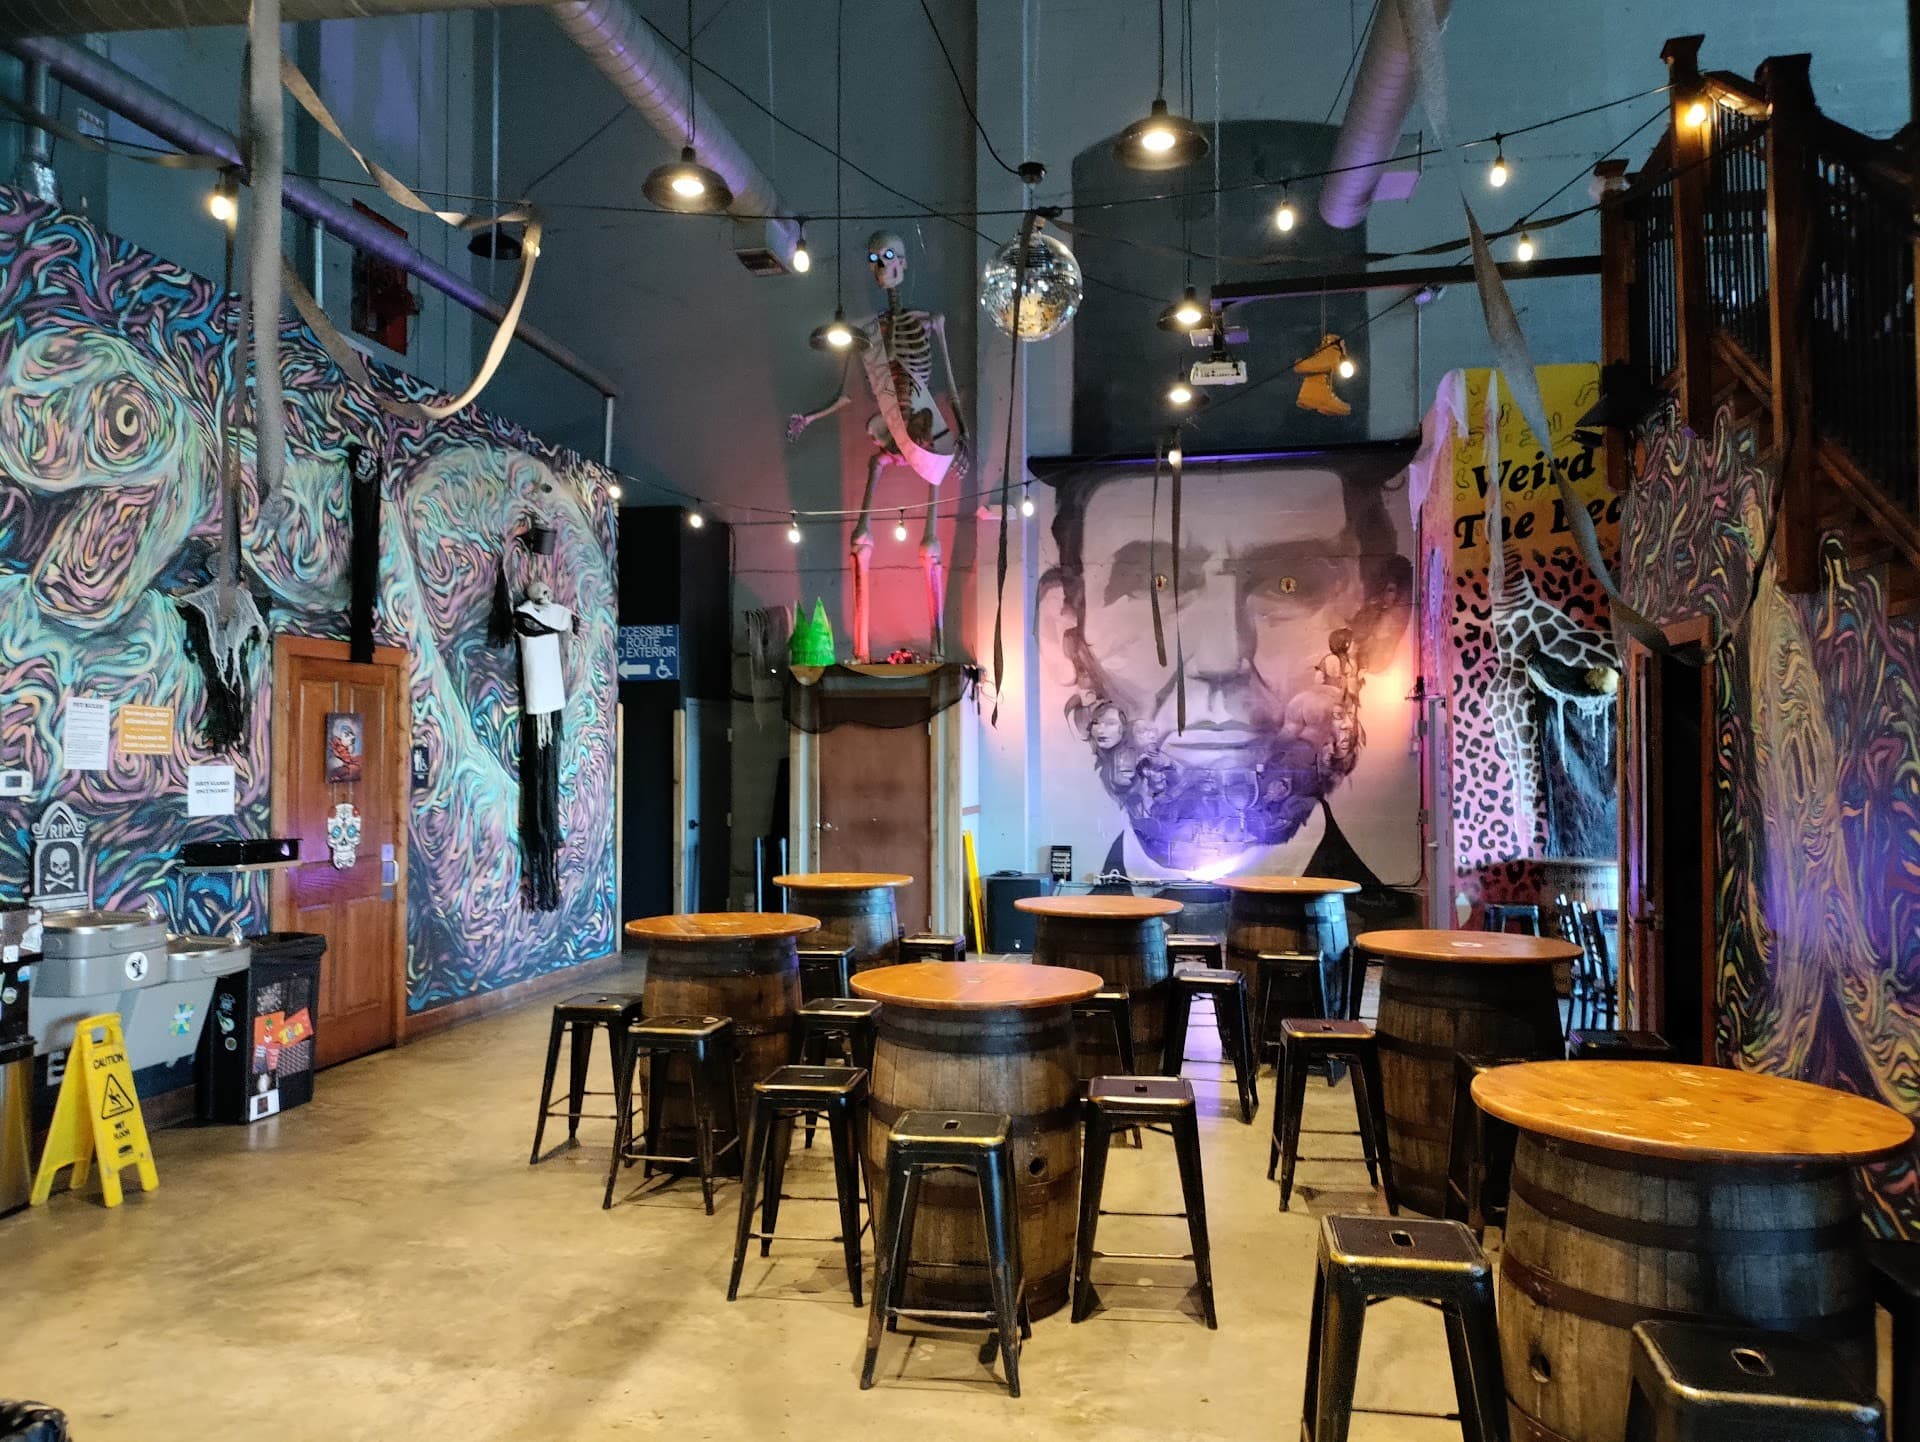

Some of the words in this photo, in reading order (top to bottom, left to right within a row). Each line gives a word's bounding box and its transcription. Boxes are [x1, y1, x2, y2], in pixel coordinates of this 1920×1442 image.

[1472, 445, 1596, 499] Weird
[618, 625, 673, 637] CCESSIBLE
[626, 636, 661, 648] ROUTE
[626, 646, 677, 658] EXTERIOR
[50, 823, 71, 839] RIP
[93, 1053, 125, 1070] CAUTION
